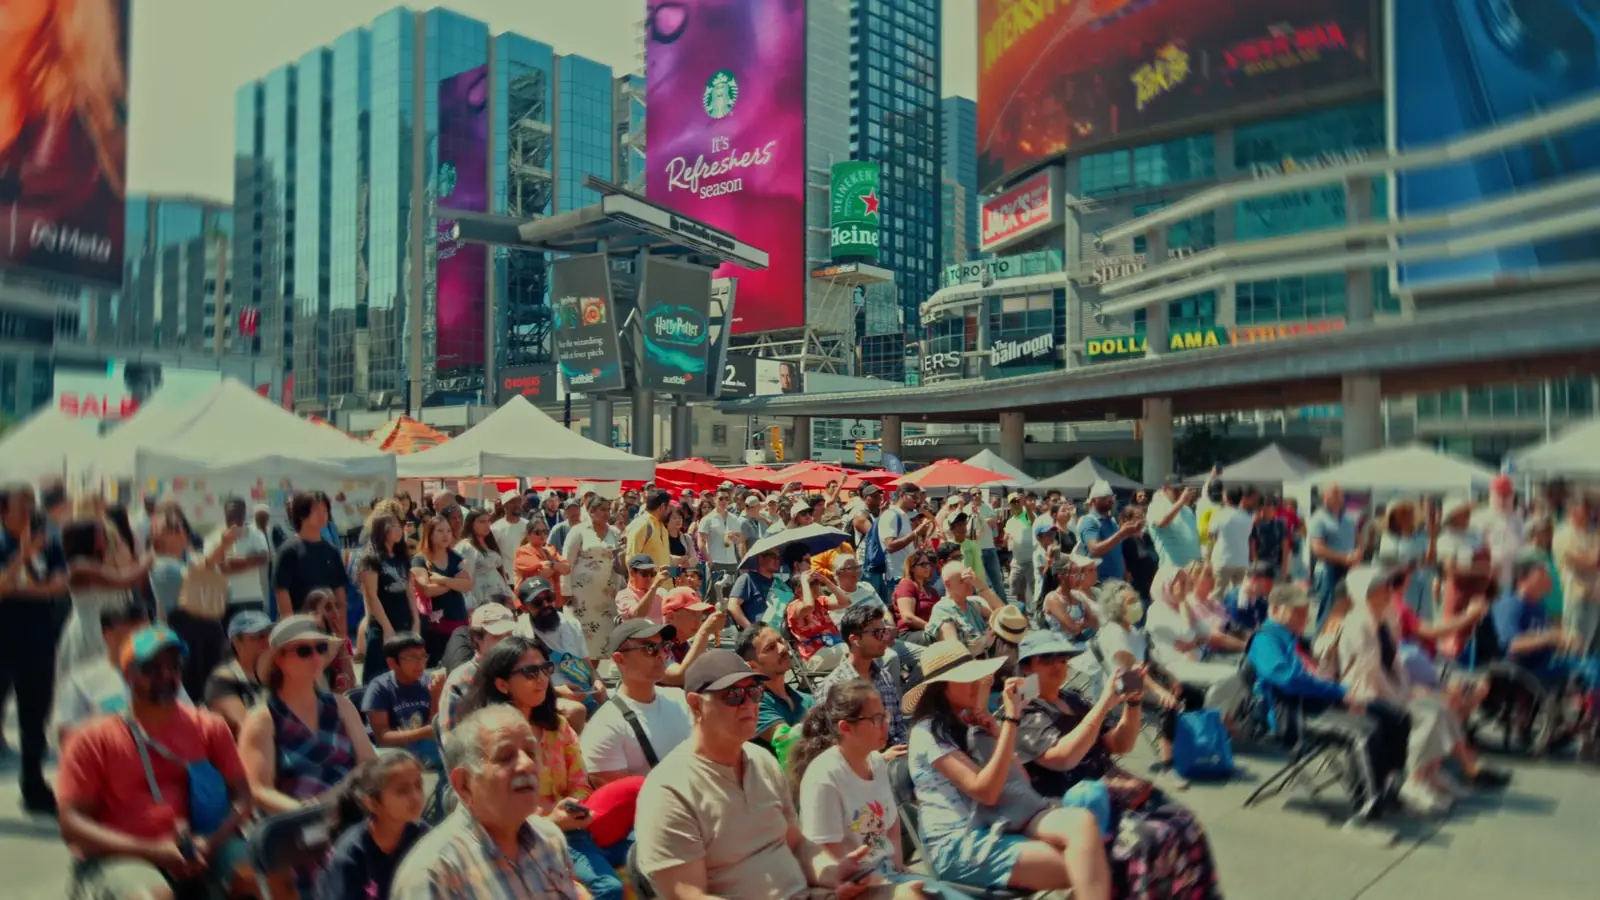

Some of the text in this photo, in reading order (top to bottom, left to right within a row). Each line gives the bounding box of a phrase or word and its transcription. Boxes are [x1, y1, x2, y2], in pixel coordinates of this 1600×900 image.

[712, 136, 729, 153] It's
[665, 141, 777, 193] Refreshers
[700, 178, 743, 199] season
[655, 316, 698, 337] Harry Potter
[991, 332, 1054, 367] ballroom
[570, 374, 594, 385] audible
[662, 374, 686, 385] audible
